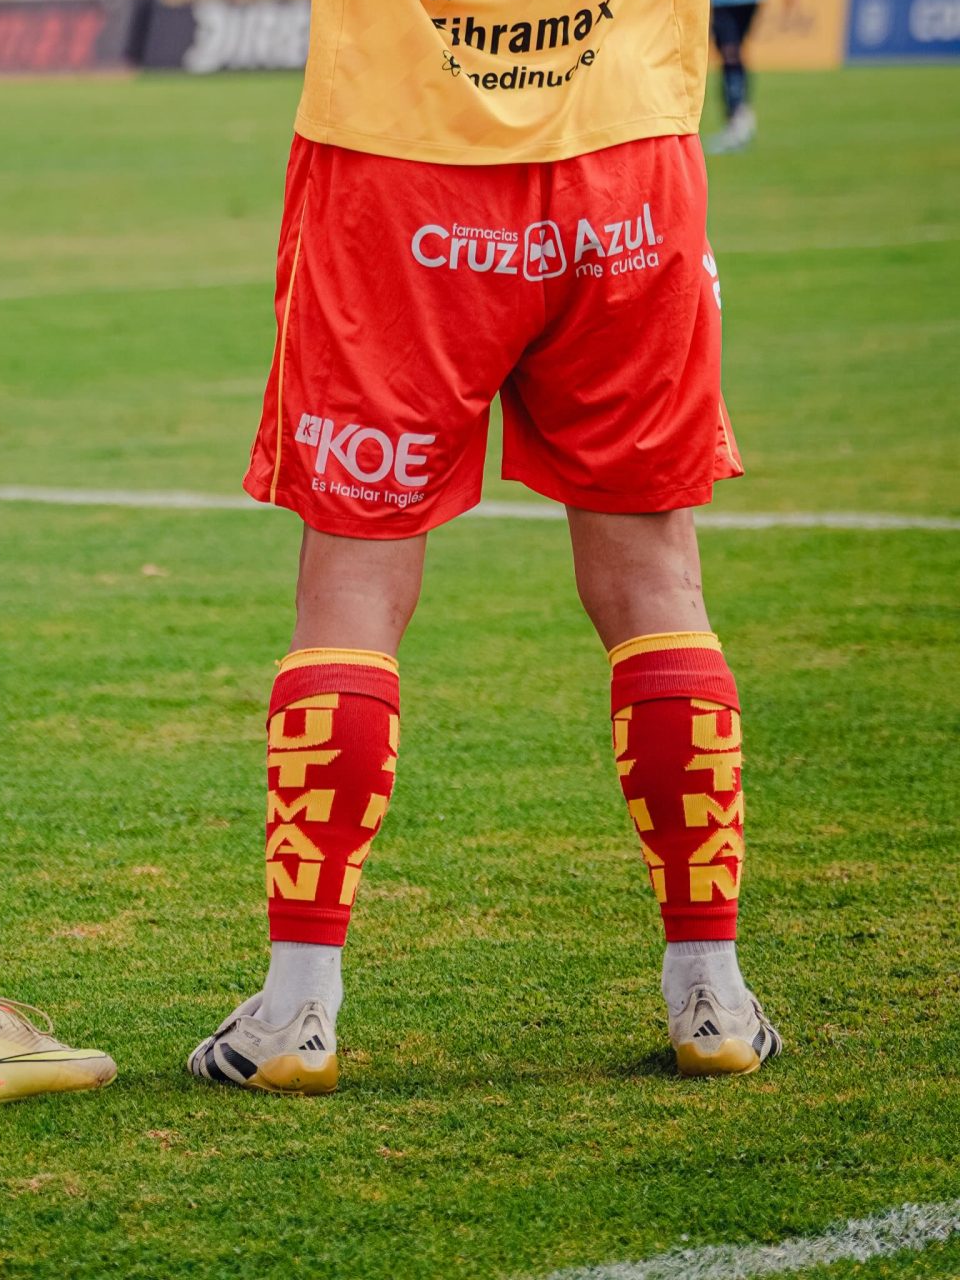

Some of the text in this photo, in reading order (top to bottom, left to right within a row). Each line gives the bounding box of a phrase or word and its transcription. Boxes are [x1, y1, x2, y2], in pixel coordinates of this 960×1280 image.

[452, 222, 518, 242] farmacias
[411, 224, 518, 275] Cruz
[575, 248, 660, 278] me cuida
[314, 418, 436, 487] KOE
[311, 478, 425, 508] Es Hablar Inglés
